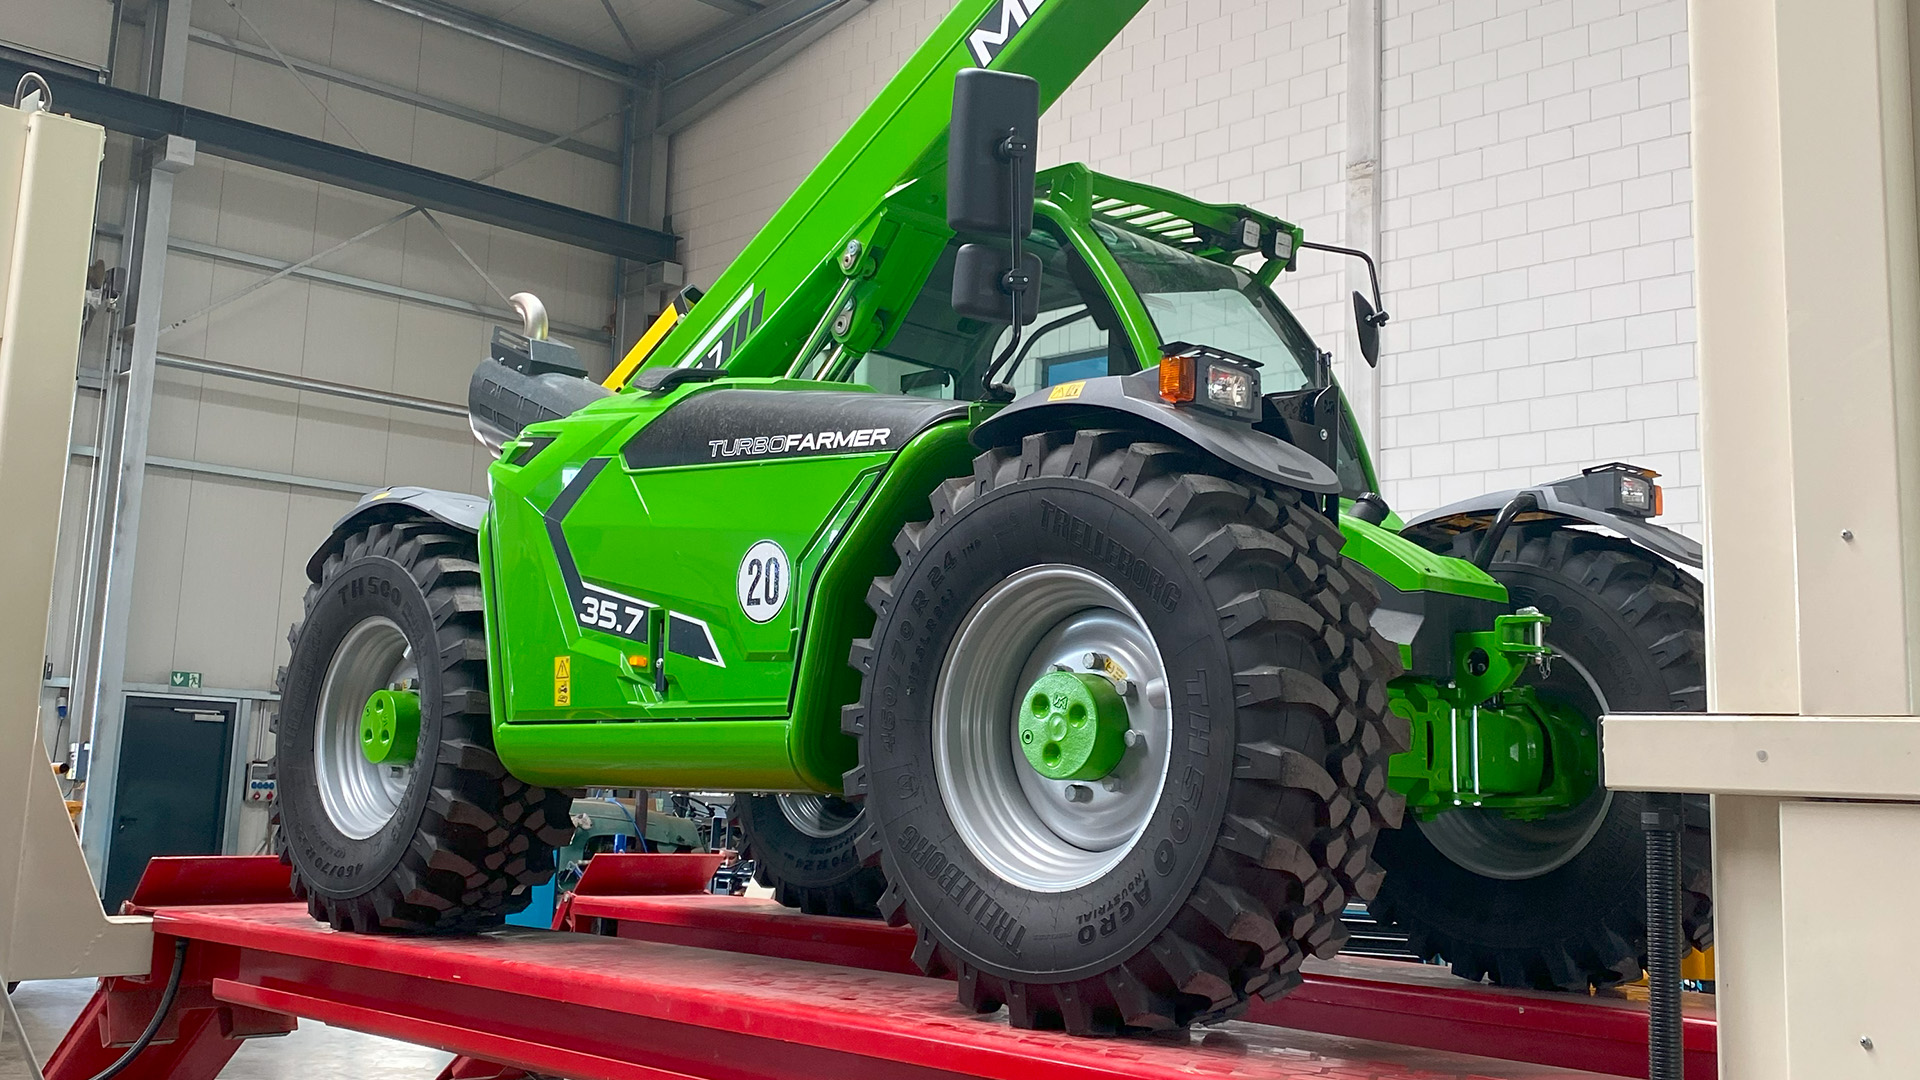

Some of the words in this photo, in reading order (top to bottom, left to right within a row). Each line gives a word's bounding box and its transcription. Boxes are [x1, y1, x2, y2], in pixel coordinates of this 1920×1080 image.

[969, 0, 1045, 68] M
[709, 428, 891, 457] TURBOFARMER
[747, 557, 780, 606] 20
[911, 588, 930, 618] R
[926, 550, 958, 589] 24
[1040, 498, 1183, 614] TRELLEBORG
[337, 576, 365, 607] TH
[367, 576, 402, 607] 500
[579, 596, 645, 635] 35.7
[1185, 667, 1213, 758] TH
[1153, 763, 1206, 879] 500
[314, 857, 364, 879] 460/70
[896, 823, 1029, 959] TRELLEBORG
[1075, 868, 1148, 924] INDUSTRIAL
[1076, 878, 1153, 946] AGRO
